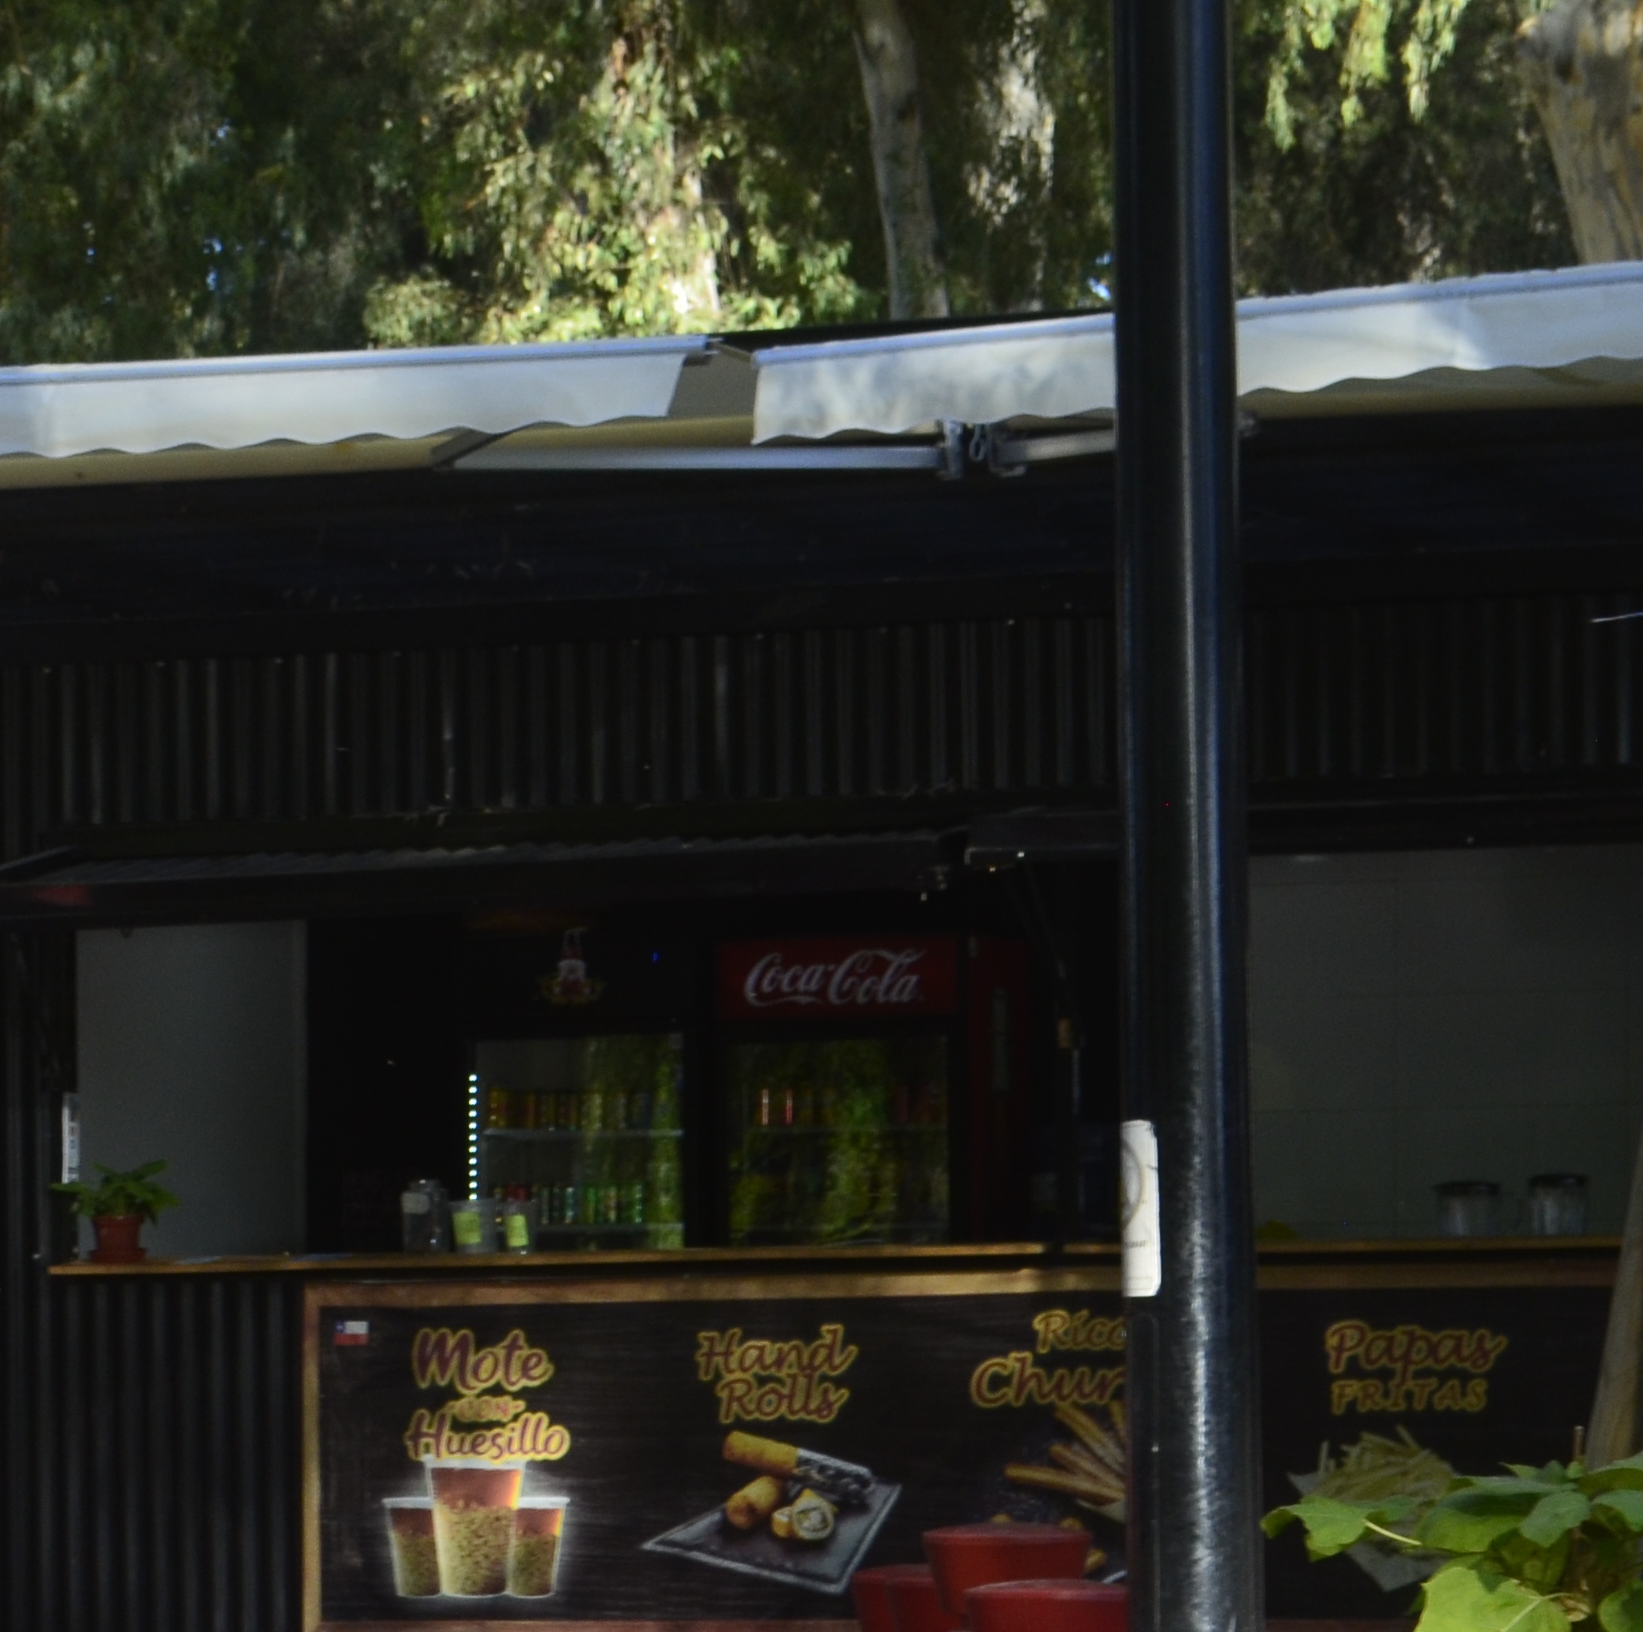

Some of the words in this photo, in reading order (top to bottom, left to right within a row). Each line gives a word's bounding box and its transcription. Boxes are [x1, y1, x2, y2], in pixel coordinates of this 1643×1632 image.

[744, 948, 927, 1007] Coca-Cola
[414, 1328, 554, 1395] Mote
[695, 1323, 858, 1381] Hand
[970, 1351, 1128, 1409] Chur
[1325, 1320, 1508, 1388] Papas
[715, 1374, 850, 1423] Rolls
[1331, 1378, 1488, 1415] FRITAS
[407, 1409, 570, 1462] Huesillo
